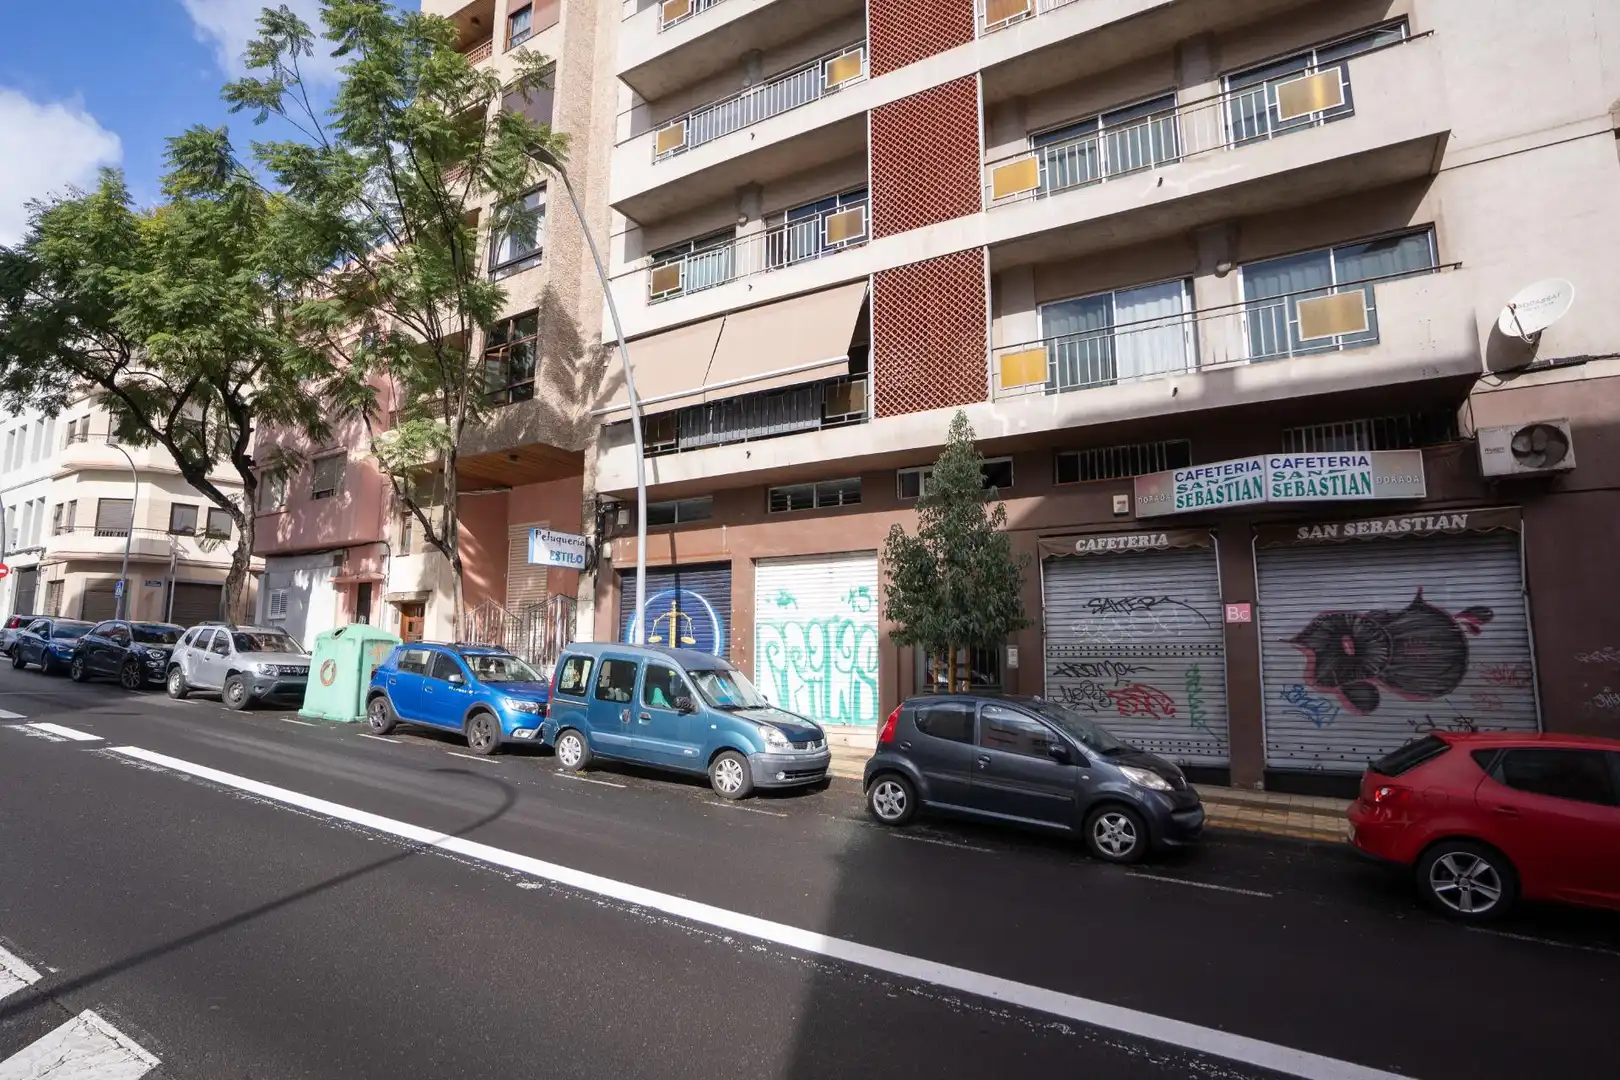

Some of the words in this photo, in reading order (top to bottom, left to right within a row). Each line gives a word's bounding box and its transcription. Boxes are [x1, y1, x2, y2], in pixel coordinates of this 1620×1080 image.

[1175, 460, 1261, 483] CAFETERIA
[1270, 455, 1369, 469] CAFETERIA
[1272, 471, 1372, 497] SEBASTIAN
[1376, 476, 1420, 484] DORADA
[1176, 475, 1263, 509] SEBASTIAN
[1297, 524, 1339, 539] SAN
[1343, 514, 1468, 537] SEBASTIAN
[1075, 534, 1169, 551] CAFETERIA
[550, 550, 583, 564] ESTILO
